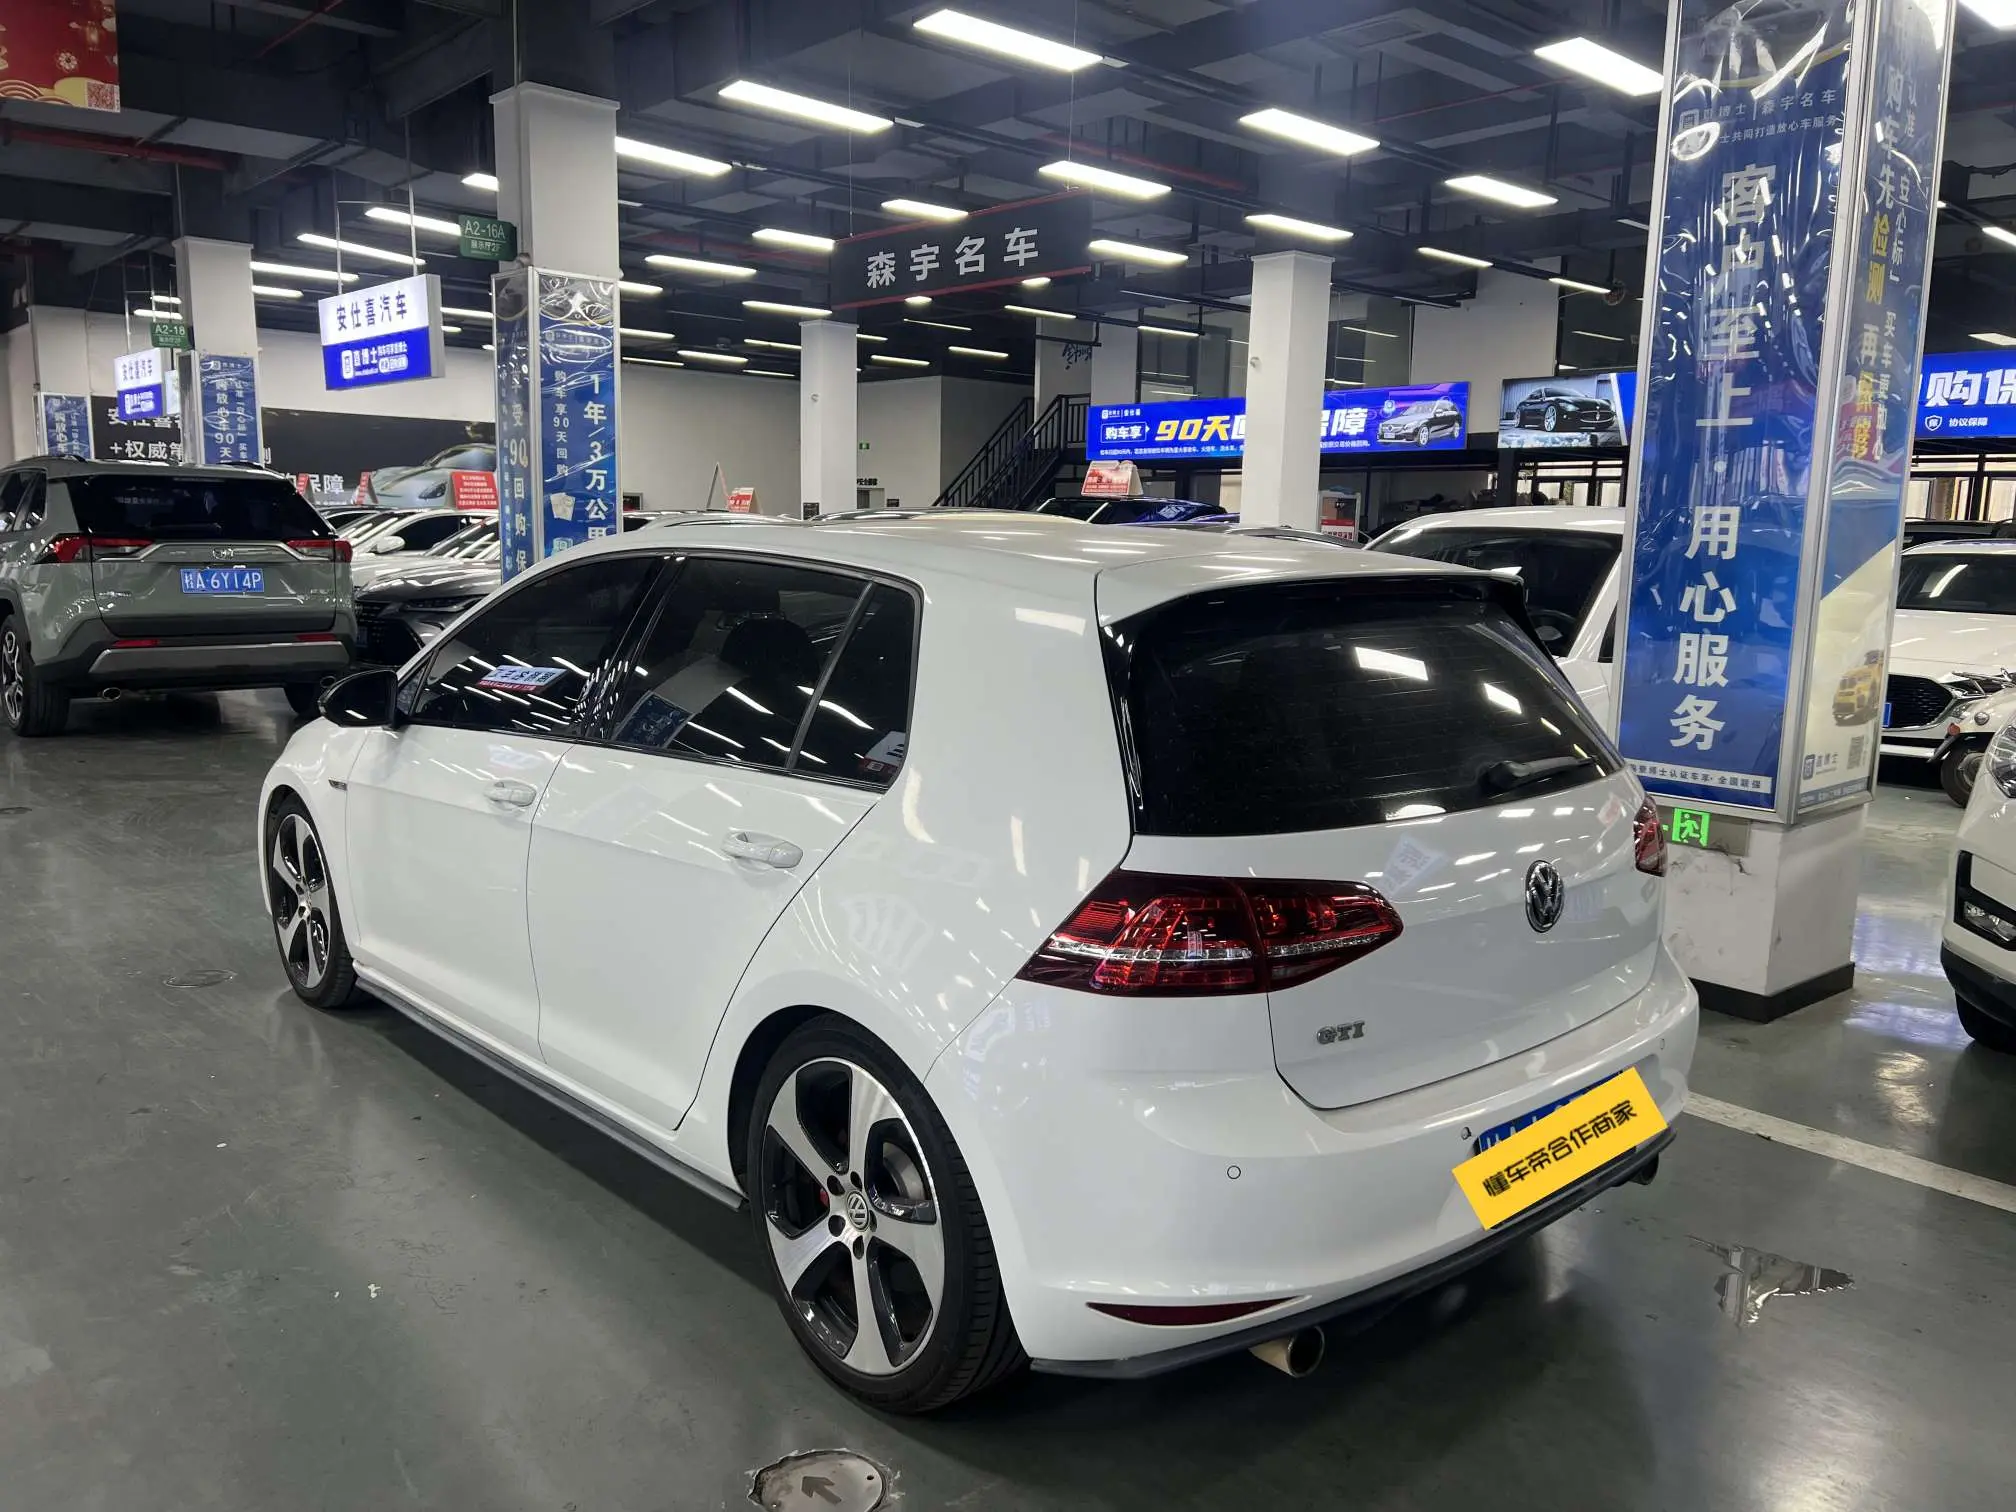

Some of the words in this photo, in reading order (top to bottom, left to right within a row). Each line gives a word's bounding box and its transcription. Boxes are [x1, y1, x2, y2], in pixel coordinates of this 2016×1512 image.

[1762, 89, 1837, 116] 森宇名车
[1720, 114, 1837, 144] 士共同打造放心车服务
[464, 220, 505, 239] A2-16A
[867, 227, 1059, 289] 森宇名车
[336, 291, 407, 331] 安仕喜汽车
[155, 324, 186, 336] A2-18
[1105, 425, 1143, 440] 购车享
[1316, 1019, 1366, 1045] GTI
